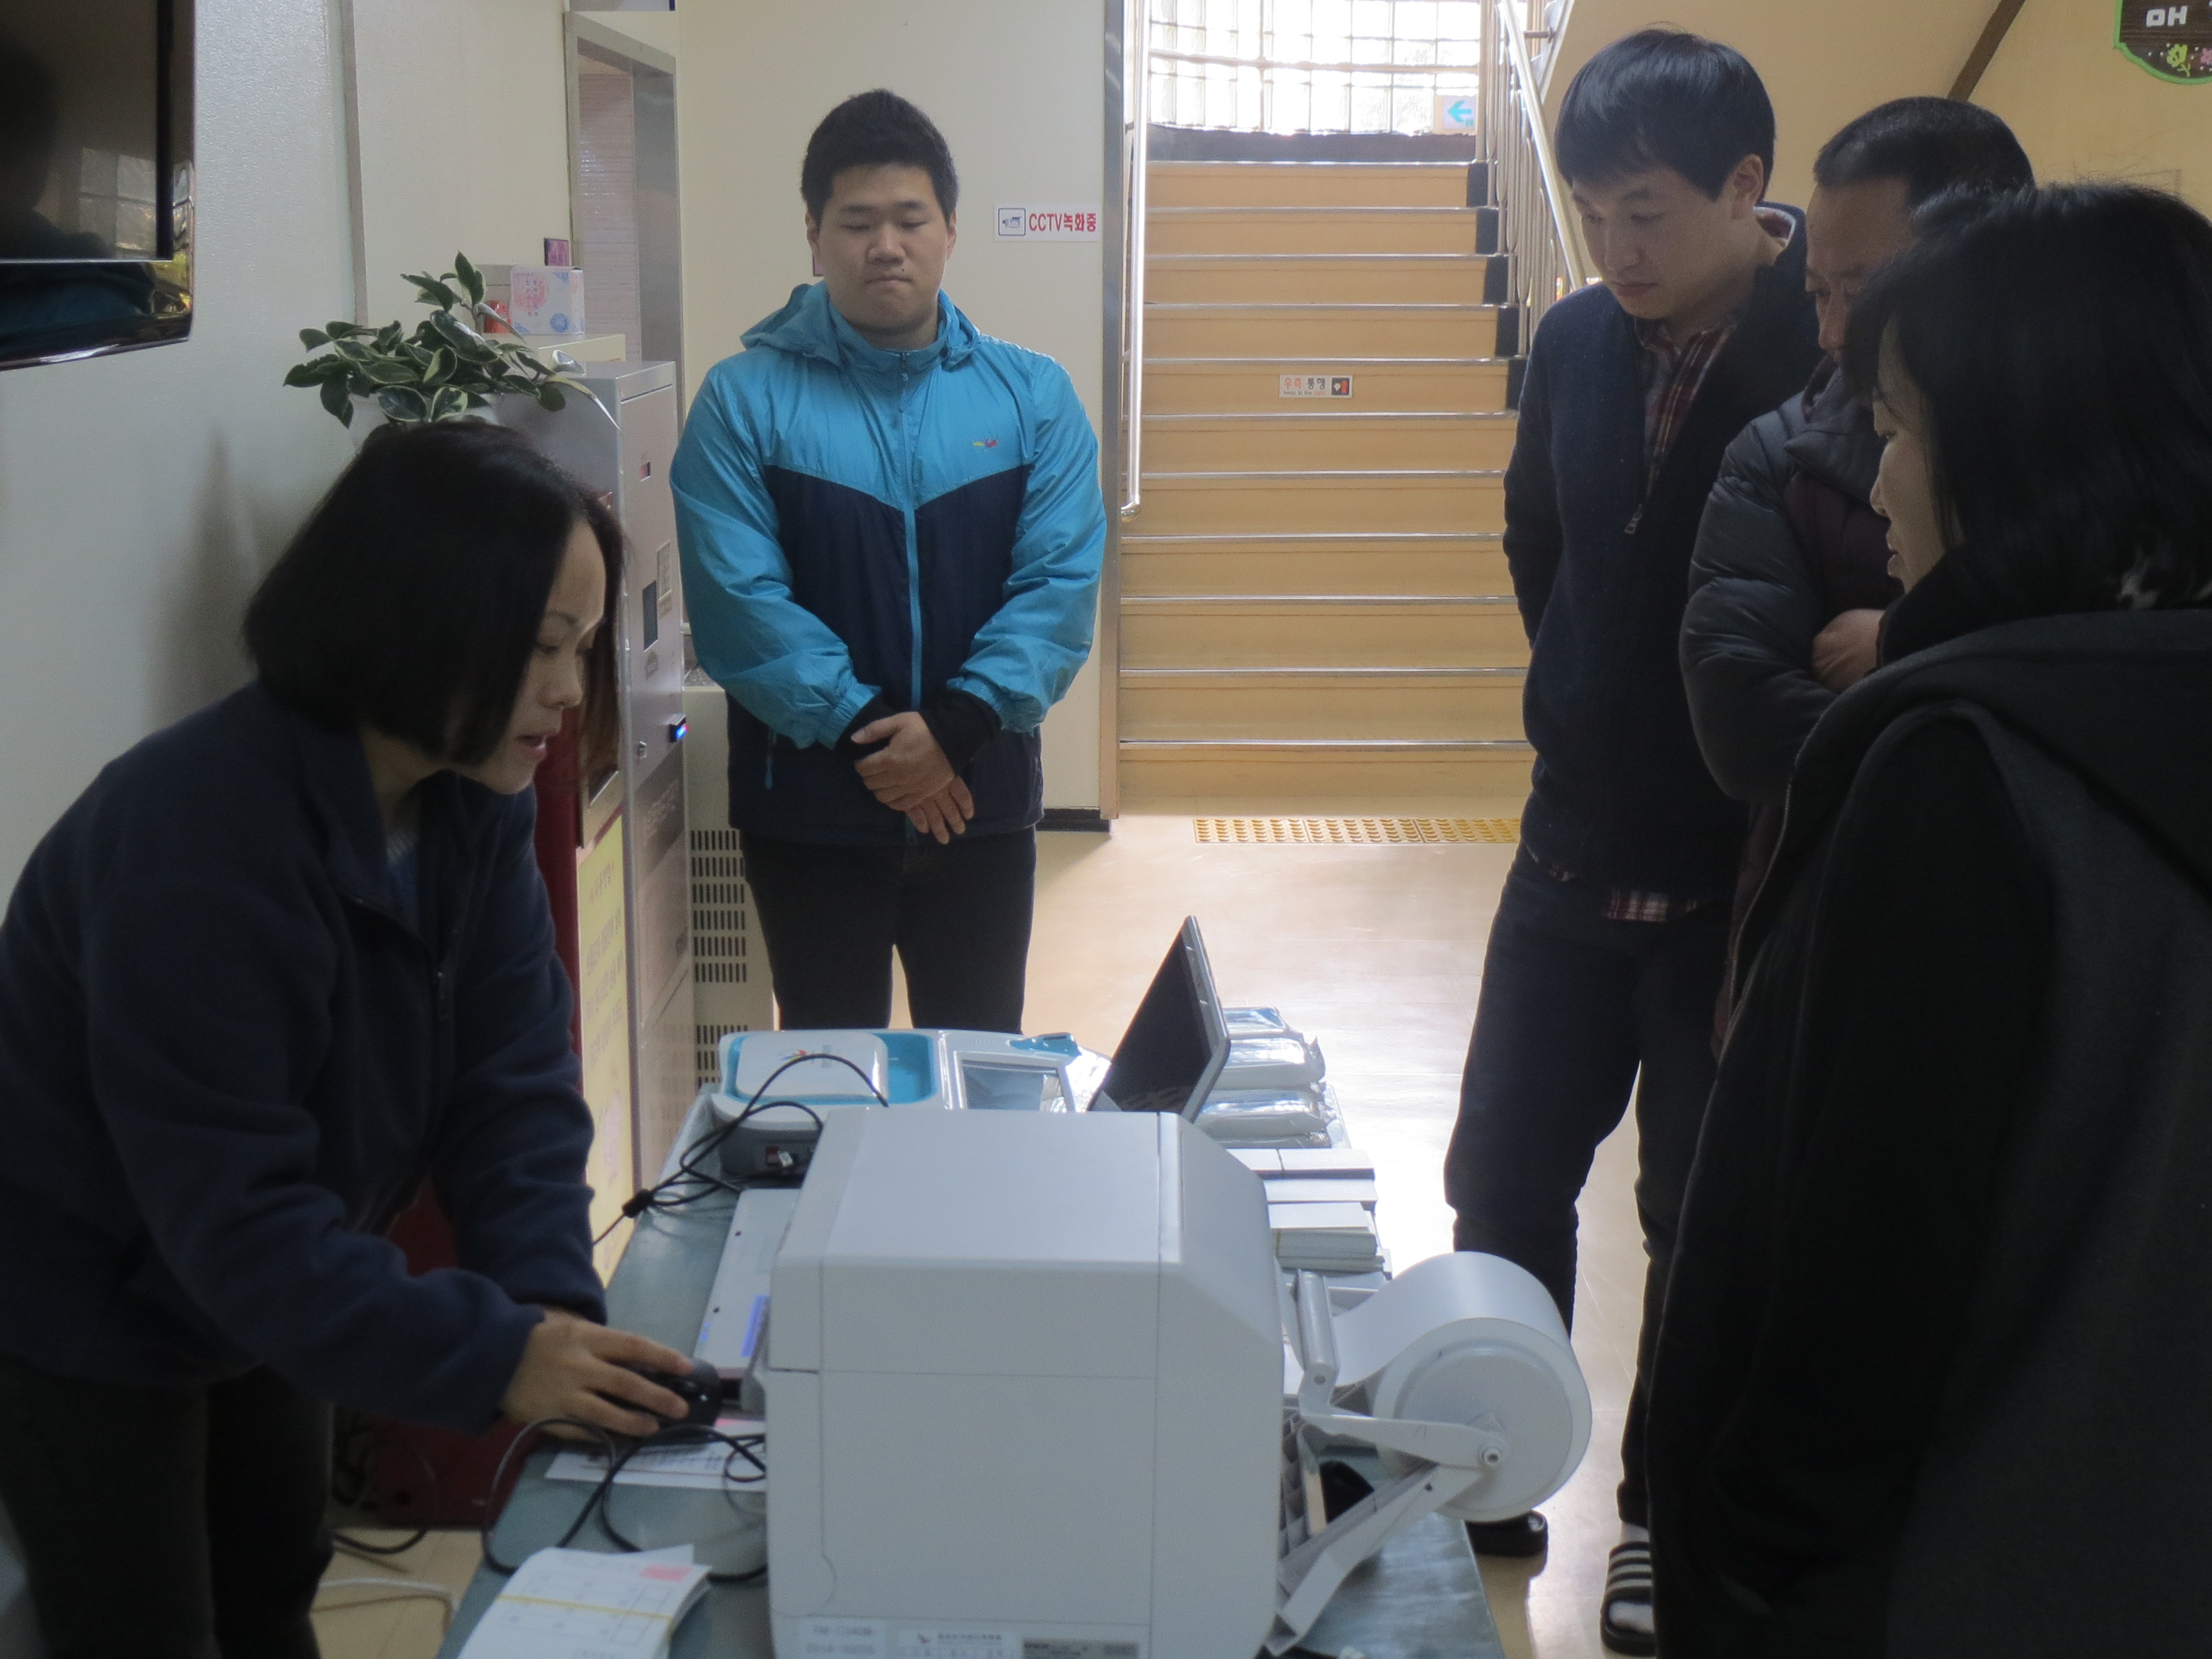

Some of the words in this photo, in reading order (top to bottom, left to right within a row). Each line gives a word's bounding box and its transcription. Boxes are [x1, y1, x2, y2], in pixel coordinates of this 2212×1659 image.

[1029, 213, 1096, 232] CCTV녹화중
[1285, 378, 1302, 389] 우측
[1307, 378, 1326, 389] 통행
